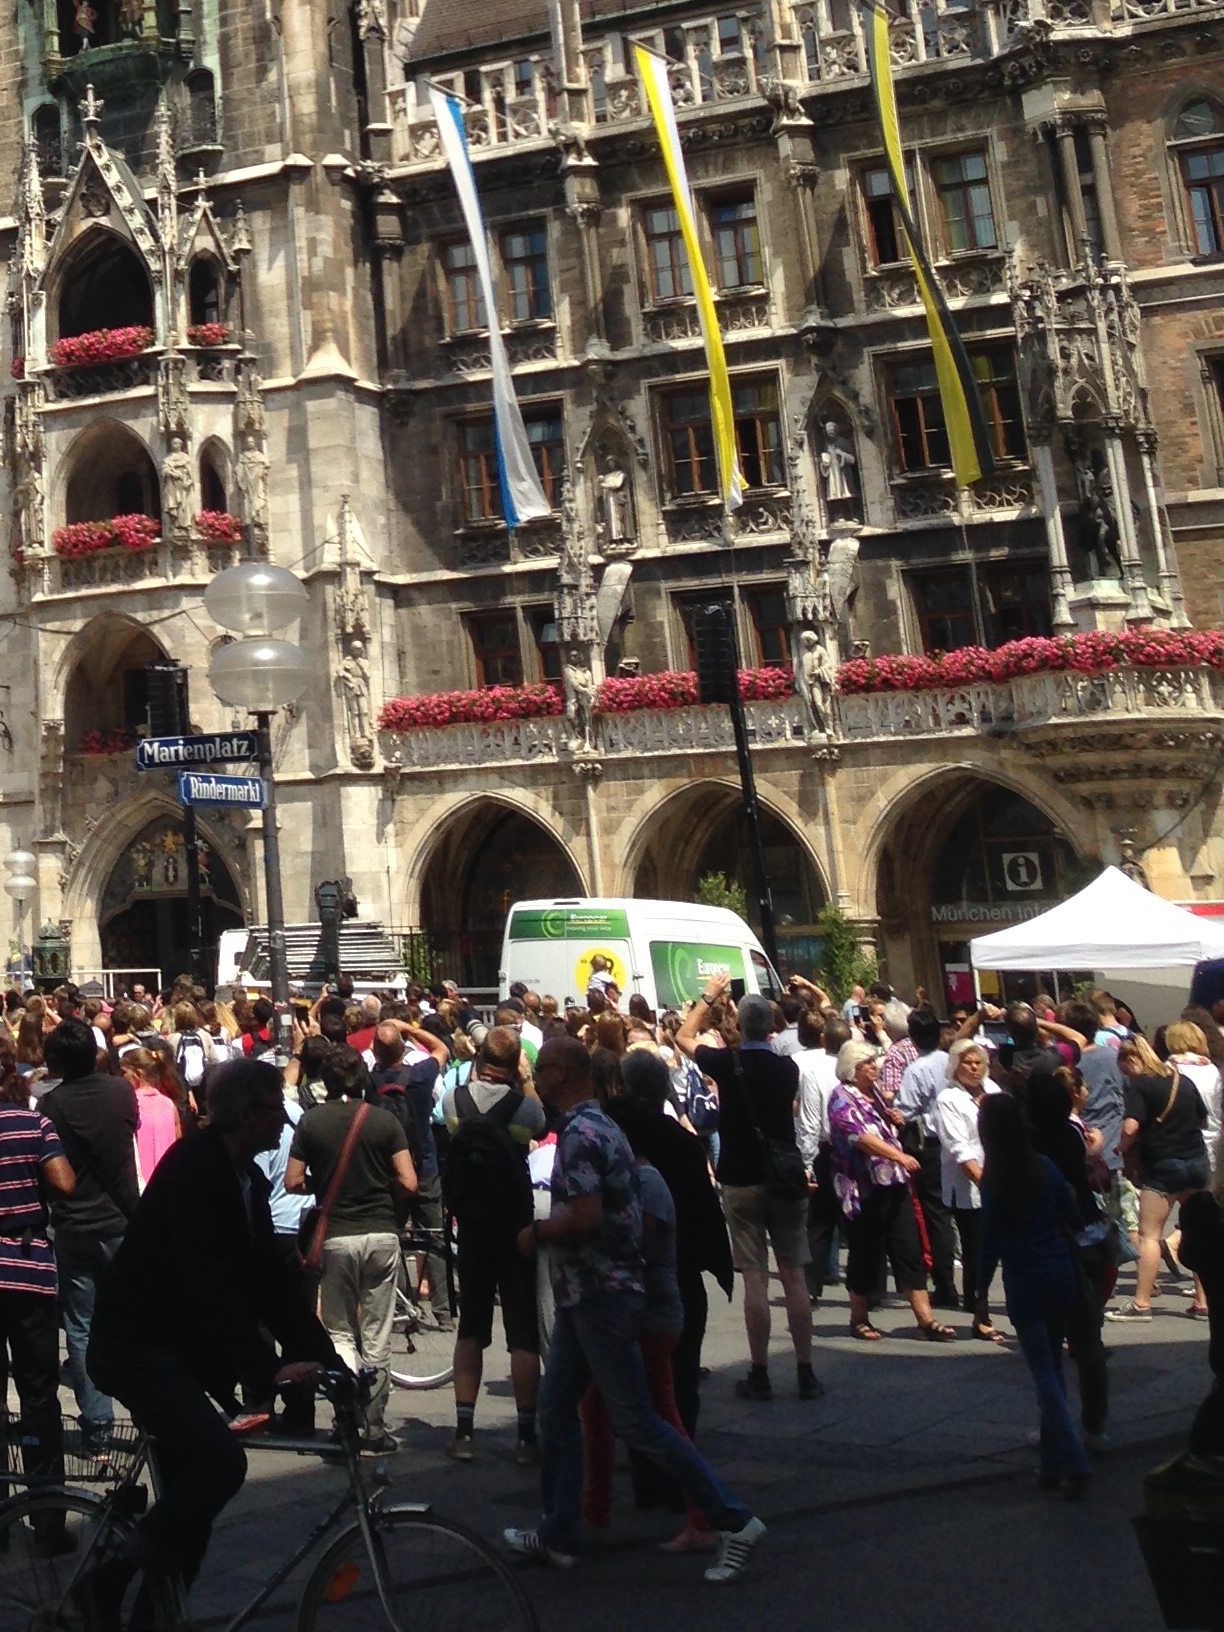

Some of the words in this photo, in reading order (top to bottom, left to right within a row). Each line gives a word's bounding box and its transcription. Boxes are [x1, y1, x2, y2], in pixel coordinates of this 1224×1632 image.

[143, 737, 250, 764] Marienplatz
[189, 776, 261, 802] Rindermarkt
[931, 903, 1012, 922] München
